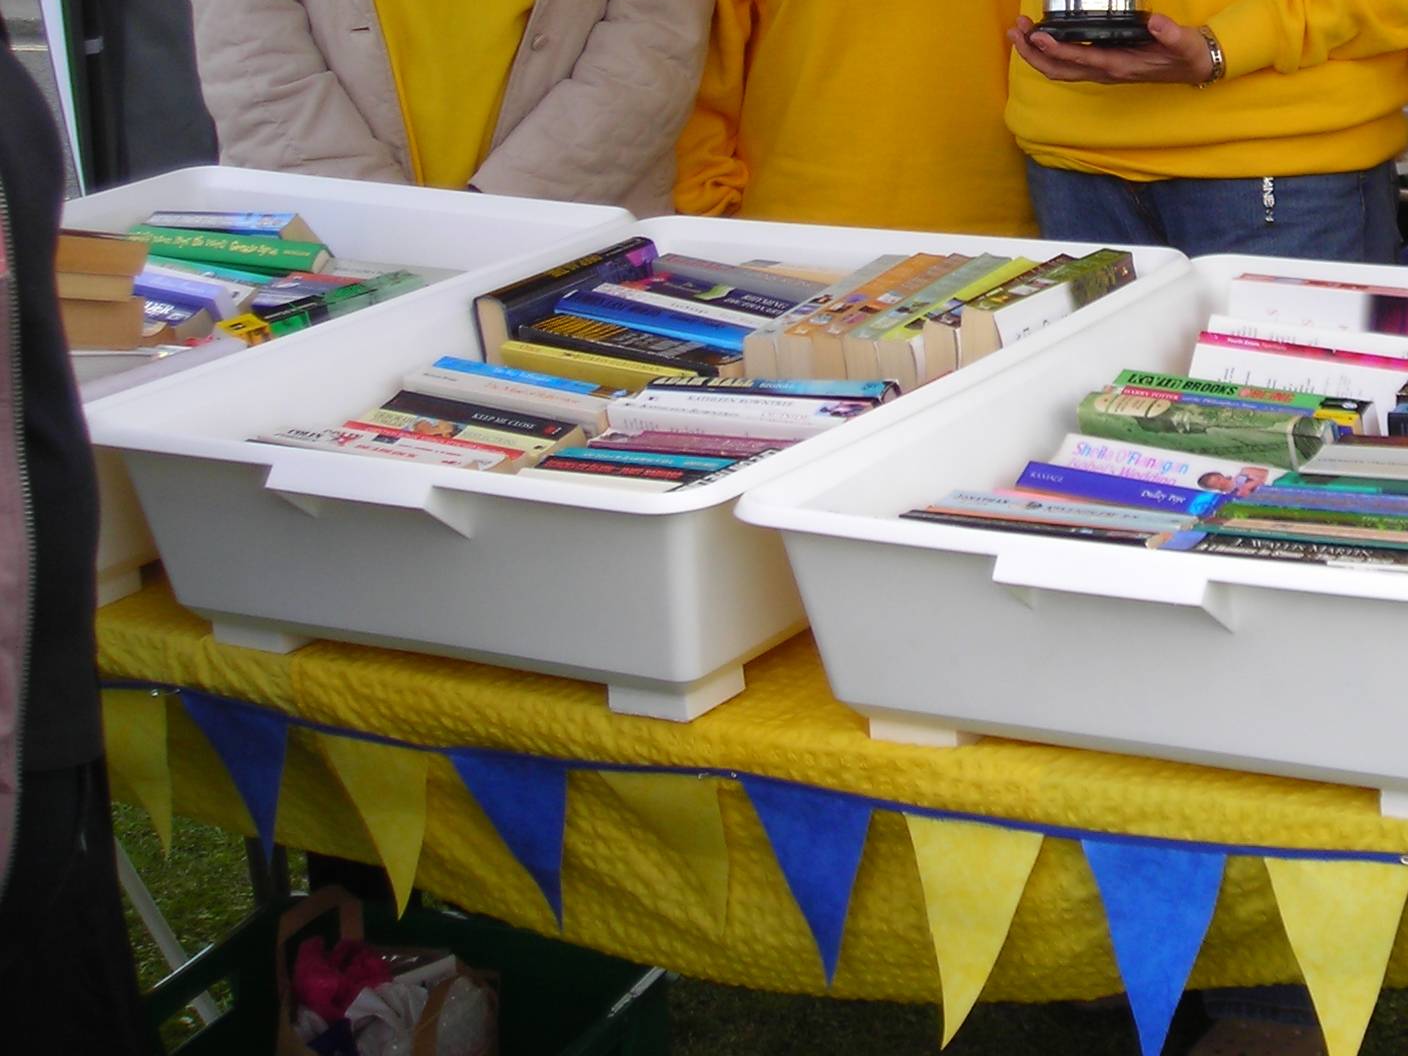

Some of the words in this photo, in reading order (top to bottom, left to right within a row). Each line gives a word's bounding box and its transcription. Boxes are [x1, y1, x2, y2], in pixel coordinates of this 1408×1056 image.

[1183, 380, 1238, 395] BROOKS
[1149, 391, 1179, 401] POTTER
[472, 412, 494, 423] KEEP
[508, 417, 537, 430] CLOSE
[1310, 544, 1373, 558] MARTIN
